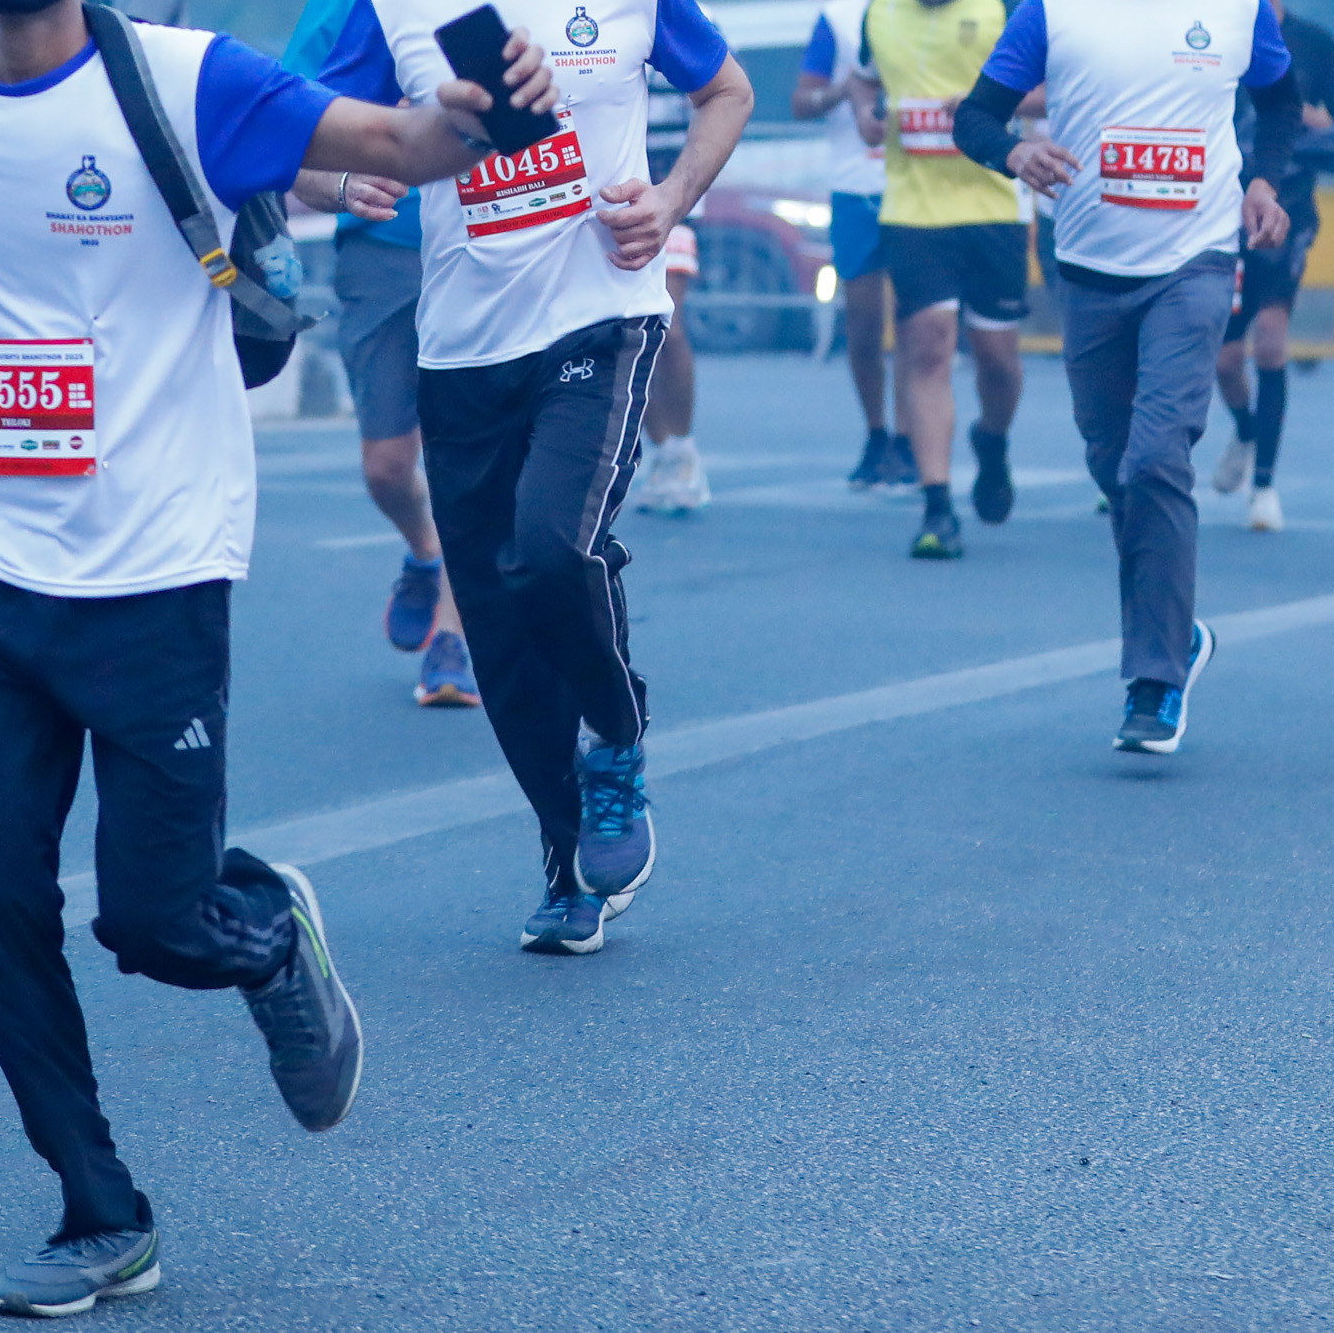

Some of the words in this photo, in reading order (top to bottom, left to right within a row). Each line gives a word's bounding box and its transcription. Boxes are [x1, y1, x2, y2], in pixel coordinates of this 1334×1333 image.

[555, 57, 616, 67] SHAHOTHON
[478, 141, 560, 187] 1045
[1122, 145, 1190, 173] 1473
[50, 222, 132, 236] SHAHOTHON
